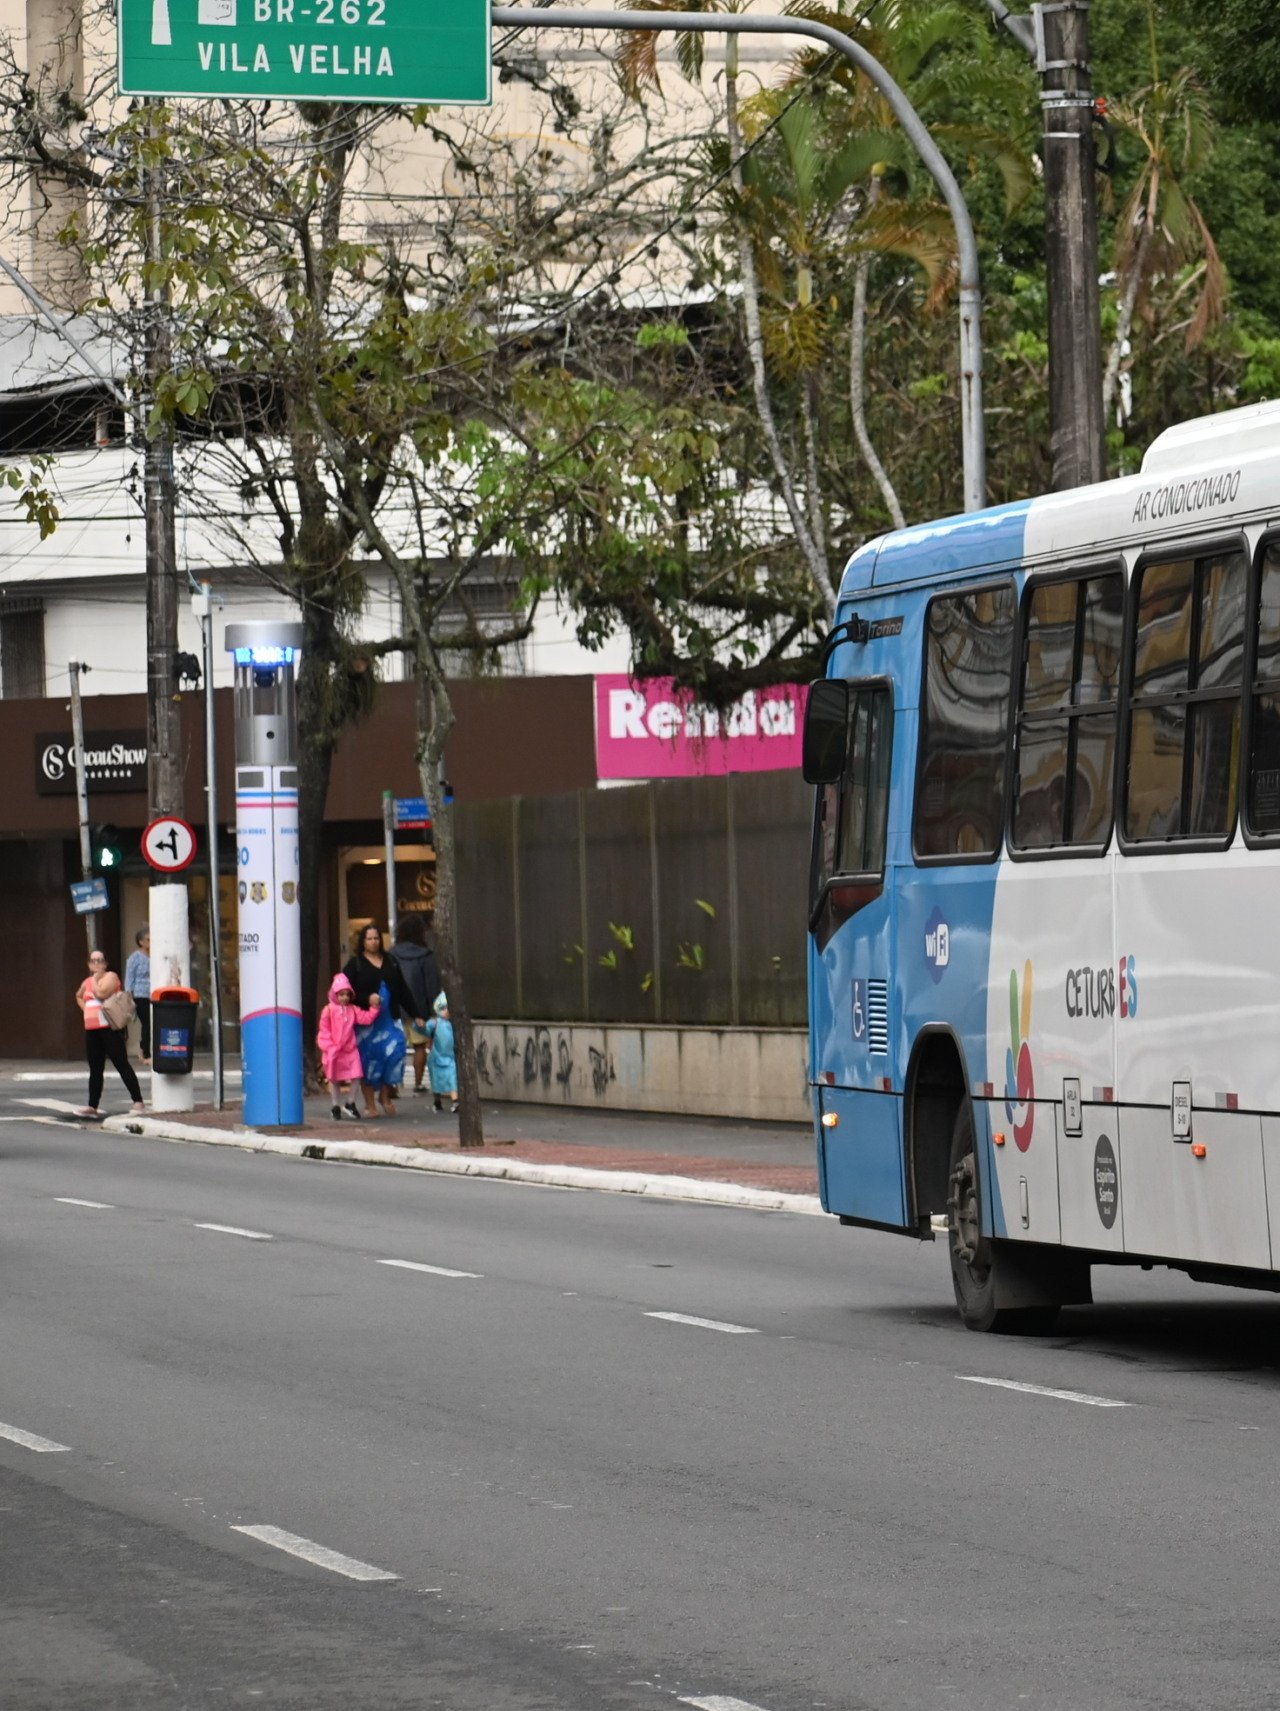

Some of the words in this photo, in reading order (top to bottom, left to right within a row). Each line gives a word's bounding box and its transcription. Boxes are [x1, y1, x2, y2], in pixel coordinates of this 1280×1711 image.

[253, 0, 387, 26] BR-262
[198, 42, 271, 73] VILA
[289, 44, 394, 76] VELHA
[1132, 491, 1151, 523] AR
[1151, 470, 1241, 519] CONDICIONADO
